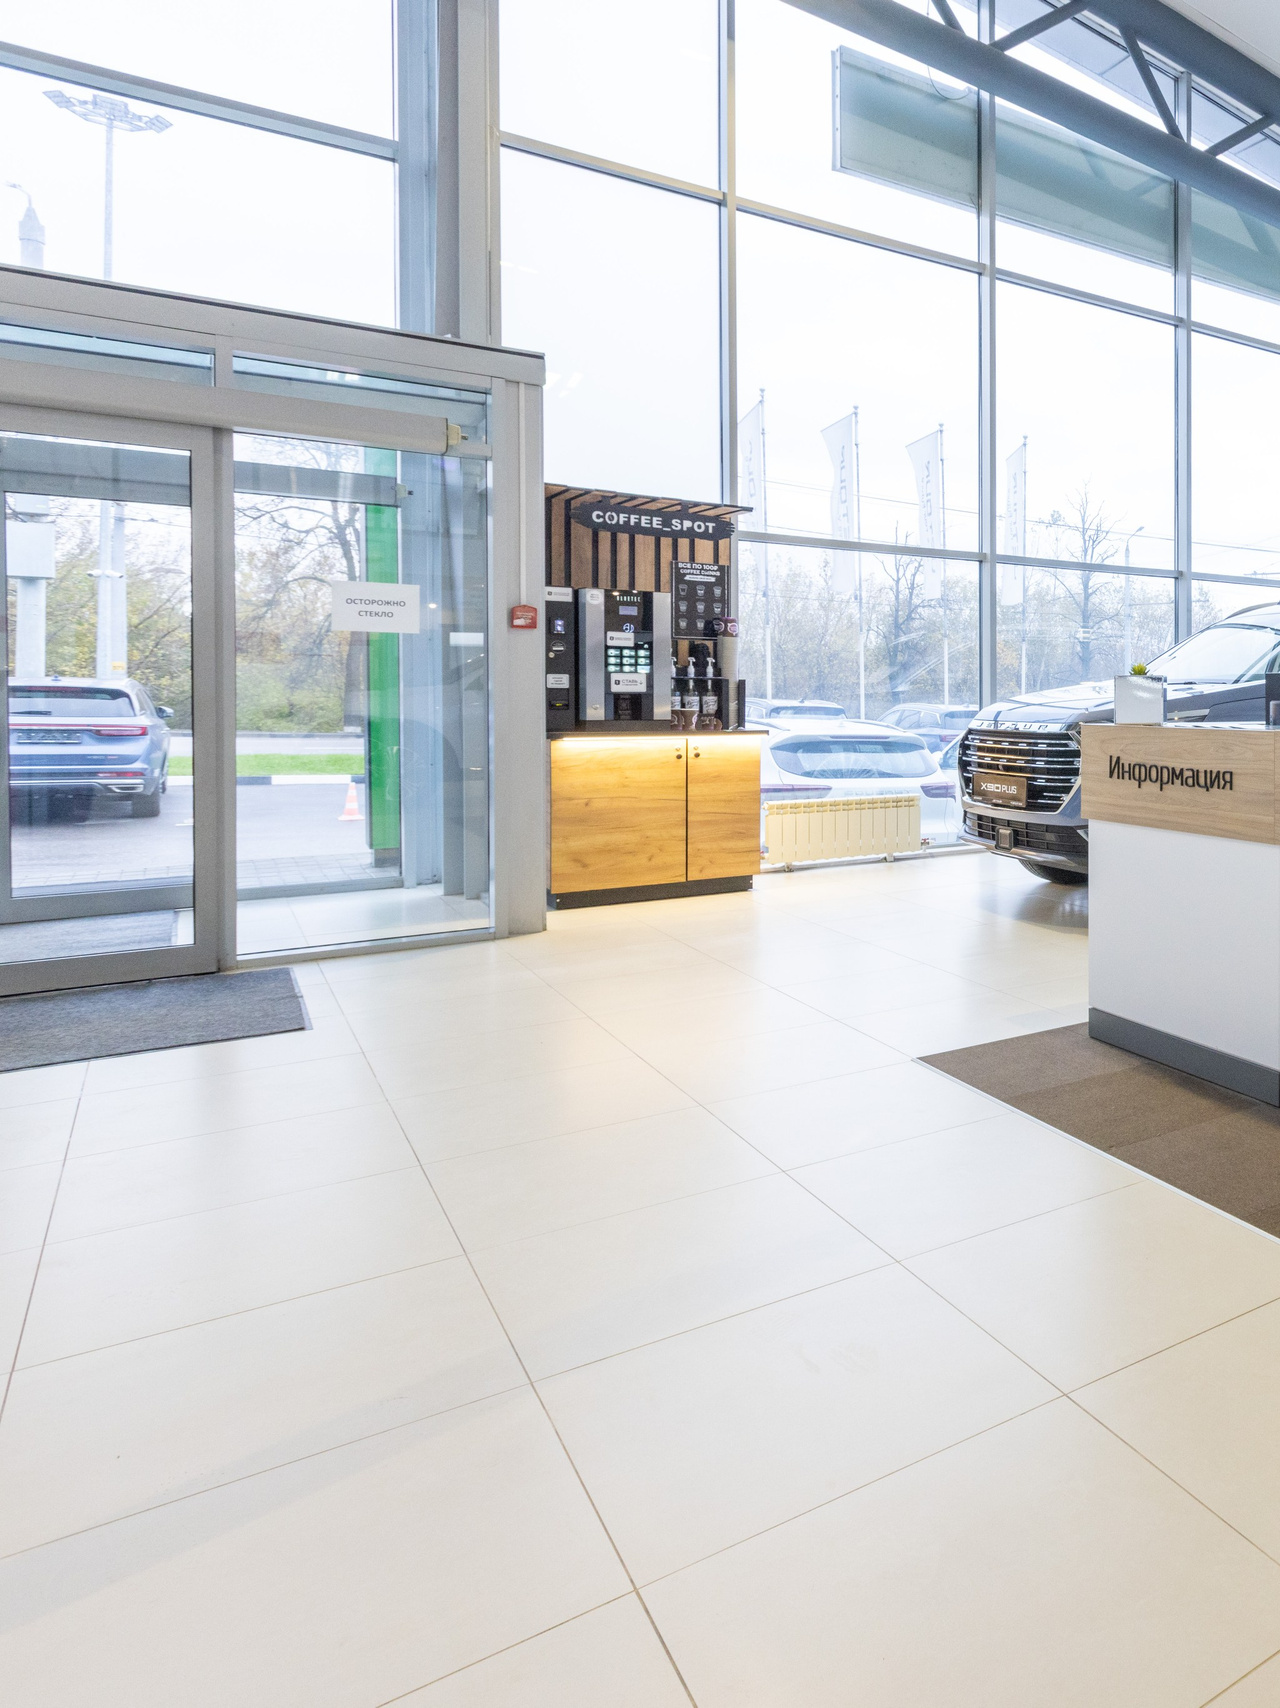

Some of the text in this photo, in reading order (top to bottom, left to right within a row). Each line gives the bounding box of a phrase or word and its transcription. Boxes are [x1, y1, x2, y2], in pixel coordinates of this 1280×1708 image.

[591, 510, 716, 534] COFFEE_SPOT
[345, 597, 407, 608] ОСТОРОЖНО
[357, 609, 395, 618] СТЕКЛО
[1108, 755, 1234, 792] Информация
[1001, 784, 1017, 794] PLUS
